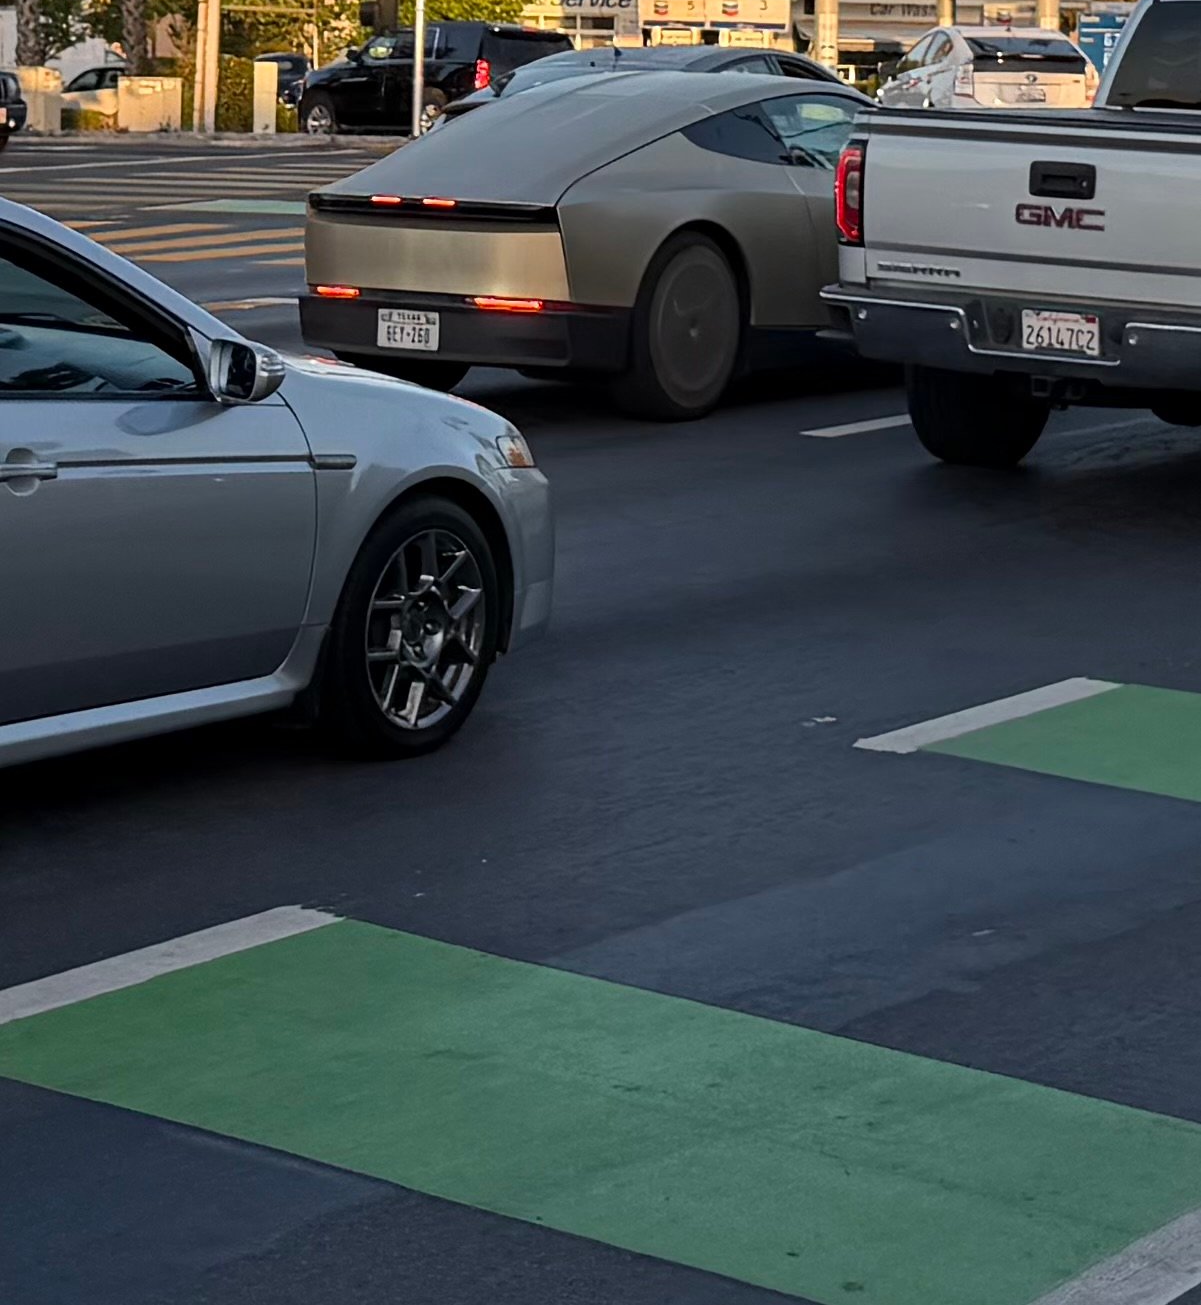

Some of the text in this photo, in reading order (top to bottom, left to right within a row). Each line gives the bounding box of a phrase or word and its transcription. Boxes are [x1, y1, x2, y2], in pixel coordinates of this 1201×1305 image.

[688, 1, 695, 10] 5
[1016, 204, 1105, 232] GMC
[1026, 325, 1096, 351] 26147C2
